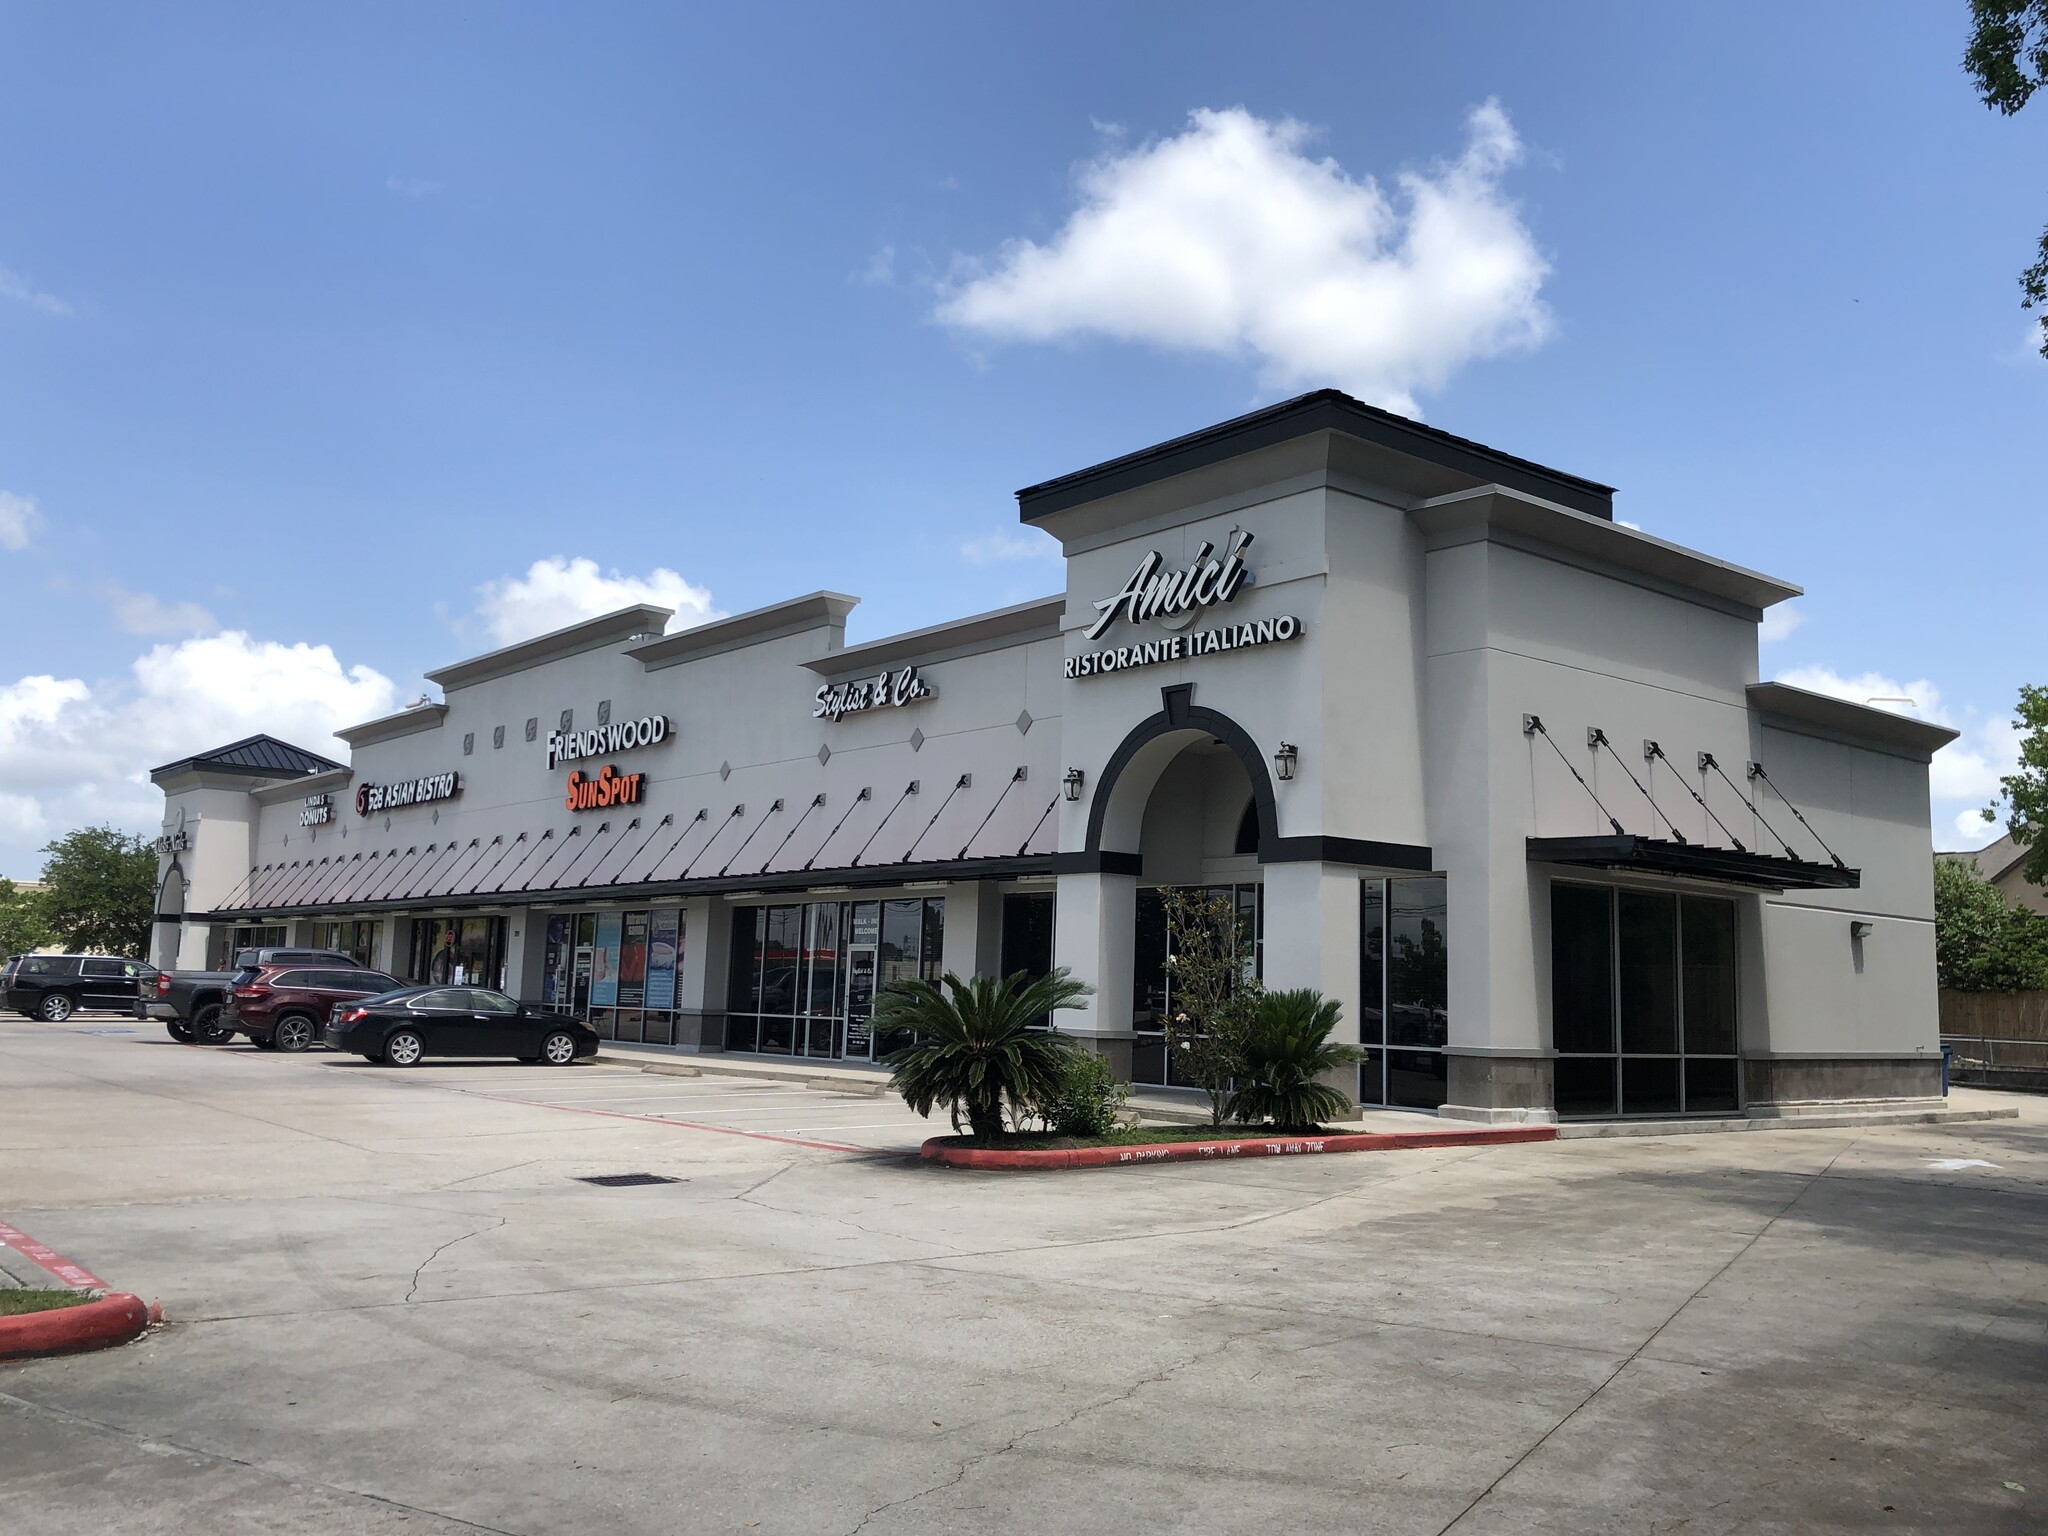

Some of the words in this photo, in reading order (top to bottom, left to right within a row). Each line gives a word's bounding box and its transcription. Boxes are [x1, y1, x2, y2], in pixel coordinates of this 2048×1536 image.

[1081, 530, 1254, 640] Amici
[1063, 635, 1185, 679] RISTORANTE
[1187, 614, 1300, 657] ITALIANO
[812, 682, 873, 722] Stylist
[874, 671, 893, 705] &
[894, 665, 930, 707] Co.
[546, 715, 668, 770] FRIENDSWOOD
[300, 806, 329, 826] DONUTS
[304, 793, 326, 808] LINDAS
[368, 786, 384, 811] 528
[384, 780, 416, 808] ASIAN
[415, 772, 458, 803] BISTRO
